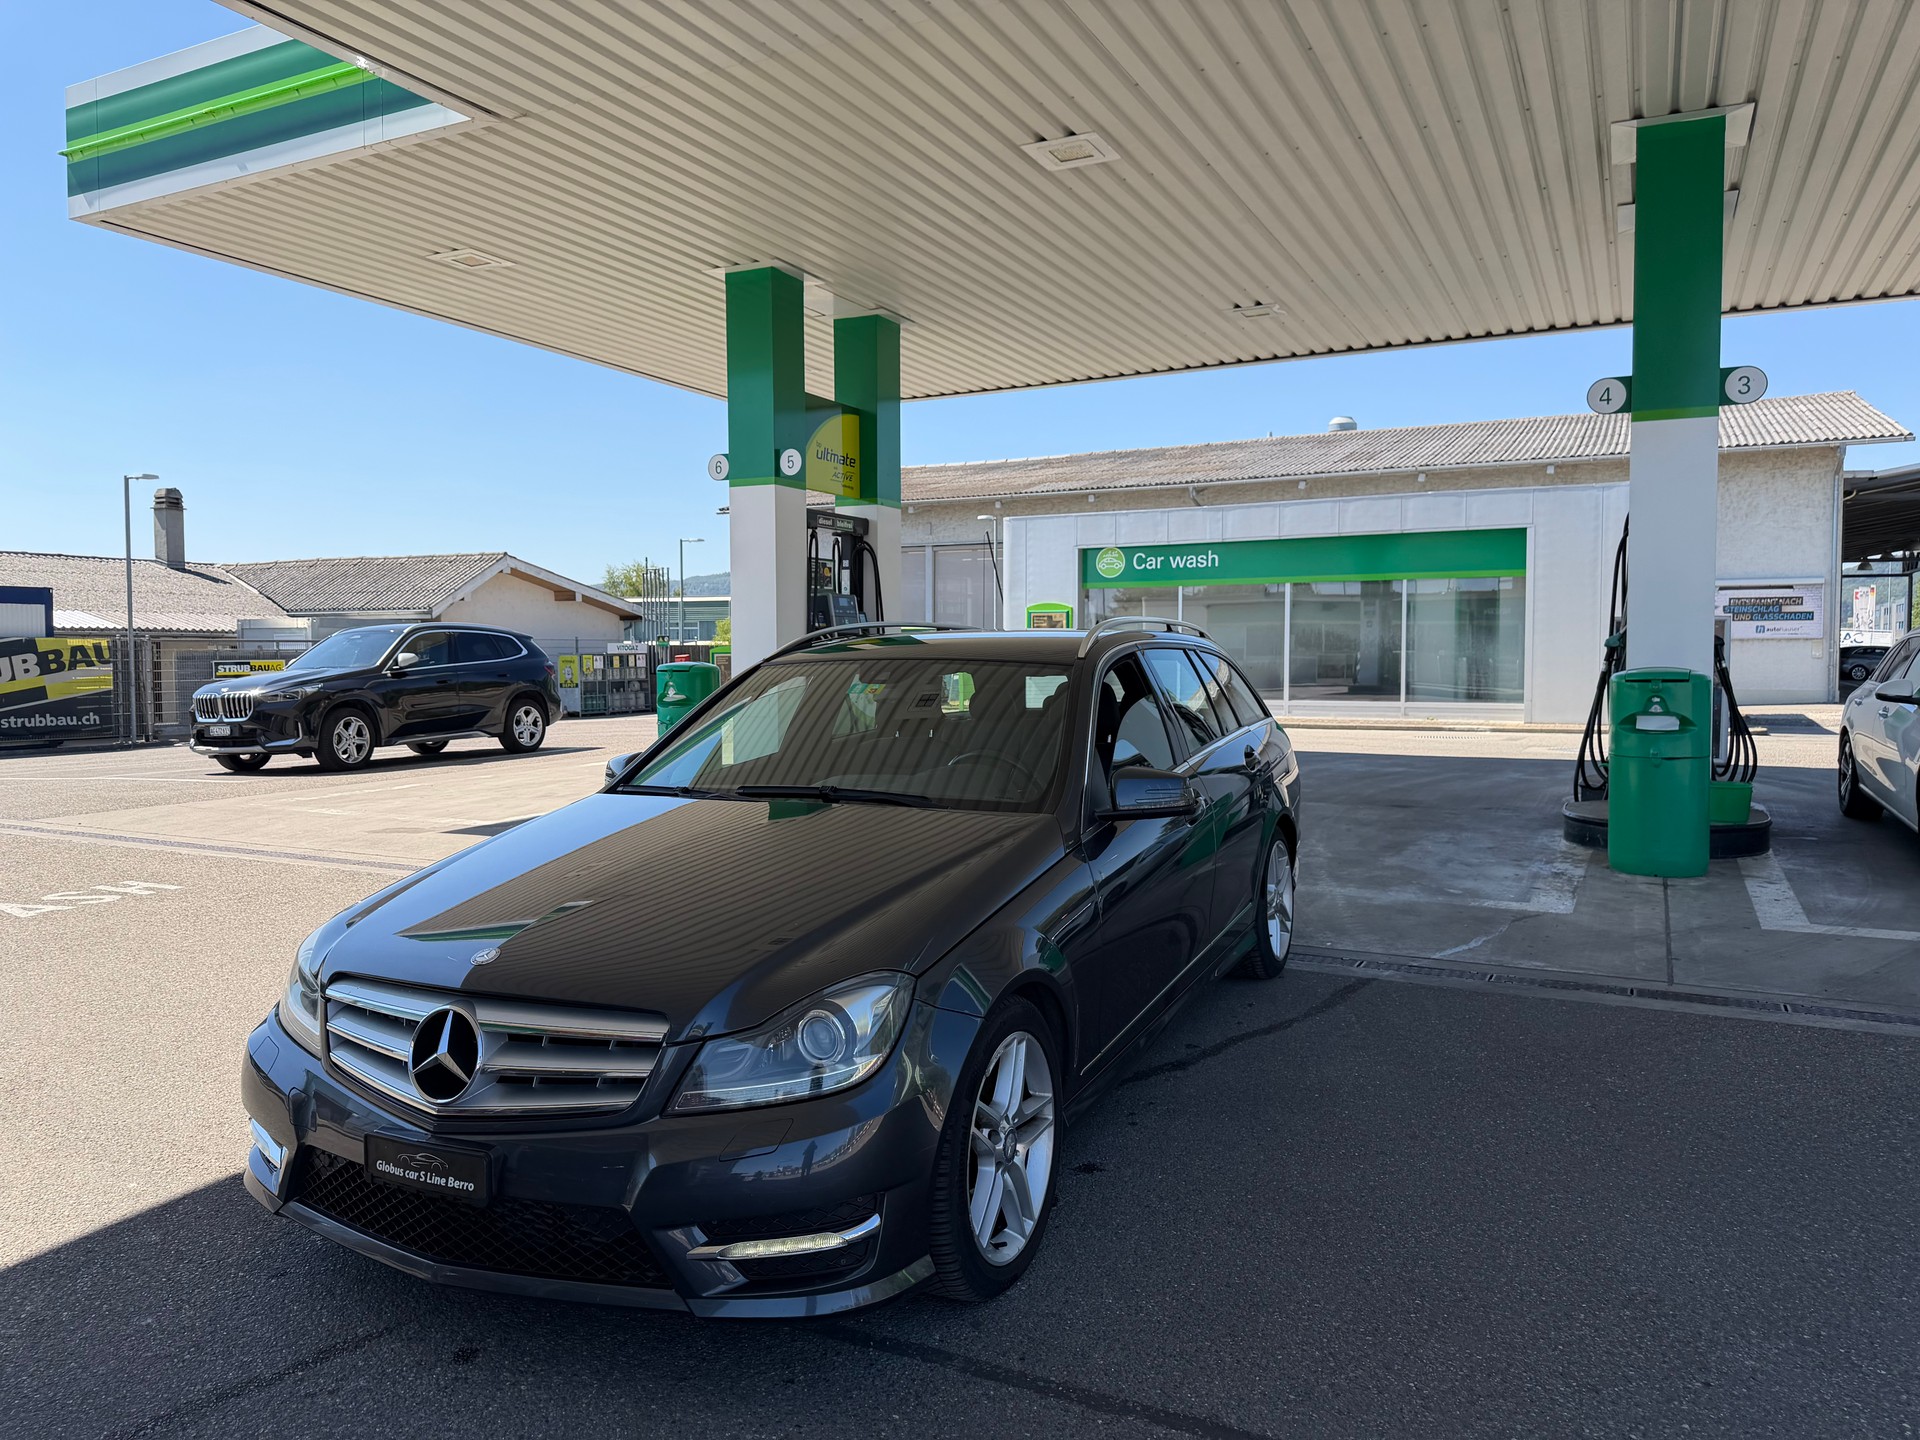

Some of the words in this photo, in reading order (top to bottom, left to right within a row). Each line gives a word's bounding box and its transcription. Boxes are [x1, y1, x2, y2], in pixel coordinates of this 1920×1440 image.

[1737, 375, 1752, 395] 3
[1598, 386, 1613, 405] 4
[787, 455, 795, 469] 5
[816, 447, 856, 469] ultimate
[715, 460, 723, 475] 6
[831, 471, 854, 483] ACTIVE
[1132, 552, 1165, 570] Car
[1169, 550, 1219, 569] wash
[1724, 605, 1780, 613] STEINSCHLAG
[1730, 598, 1778, 606] ENTSPANNT
[1779, 597, 1803, 605] NACH
[1734, 613, 1751, 621] UND
[1752, 612, 1813, 621] GLASSCHADEN
[0, 712, 101, 729] strubbau.ch
[376, 1160, 404, 1177] Globus
[405, 1169, 419, 1181] car
[419, 1171, 426, 1182] S
[426, 1172, 446, 1186] Line
[447, 1176, 475, 1192] Berro
